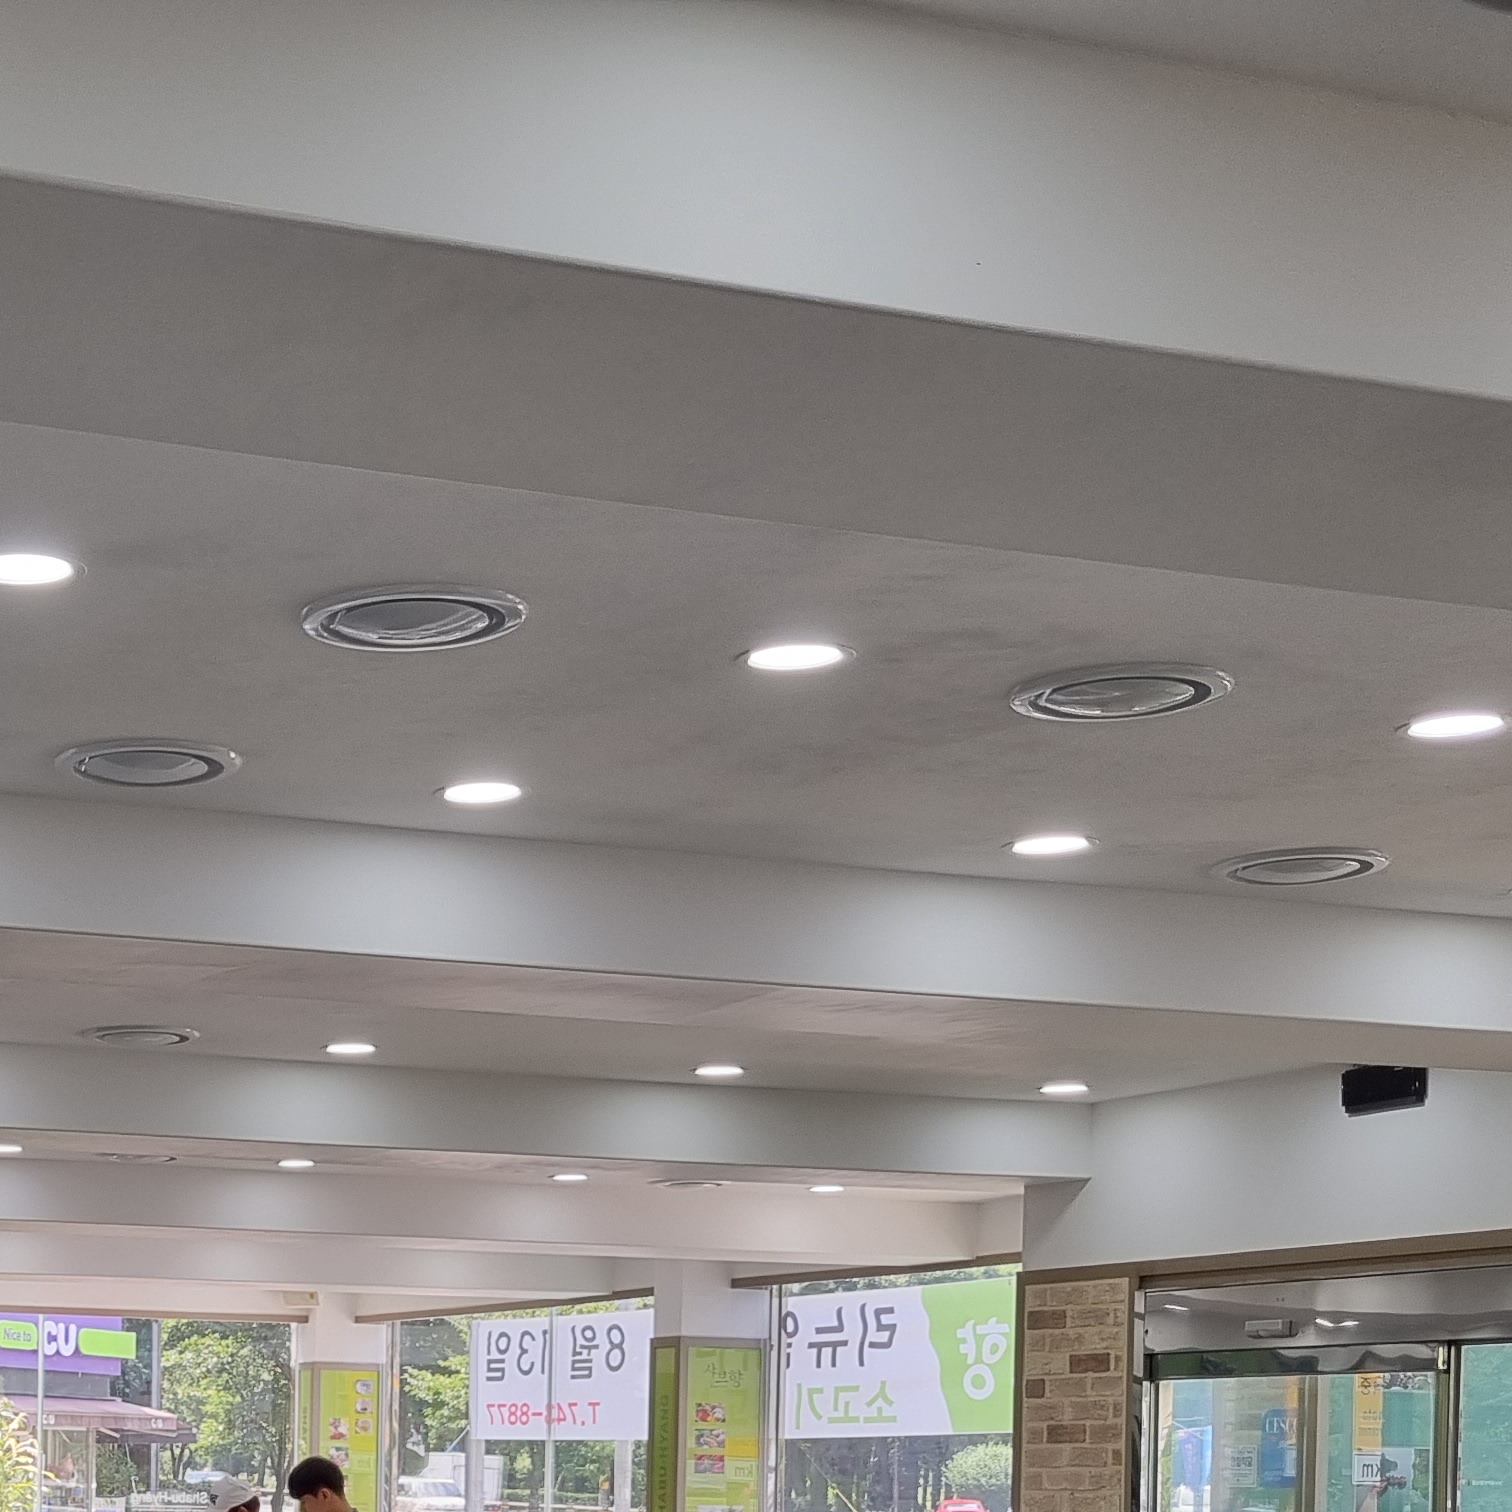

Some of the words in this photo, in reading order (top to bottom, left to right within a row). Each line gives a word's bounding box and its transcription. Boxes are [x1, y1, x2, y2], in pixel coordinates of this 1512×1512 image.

[3, 1327, 21, 1342] Nice
[23, 1331, 32, 1343] to
[43, 1320, 77, 1357] CU
